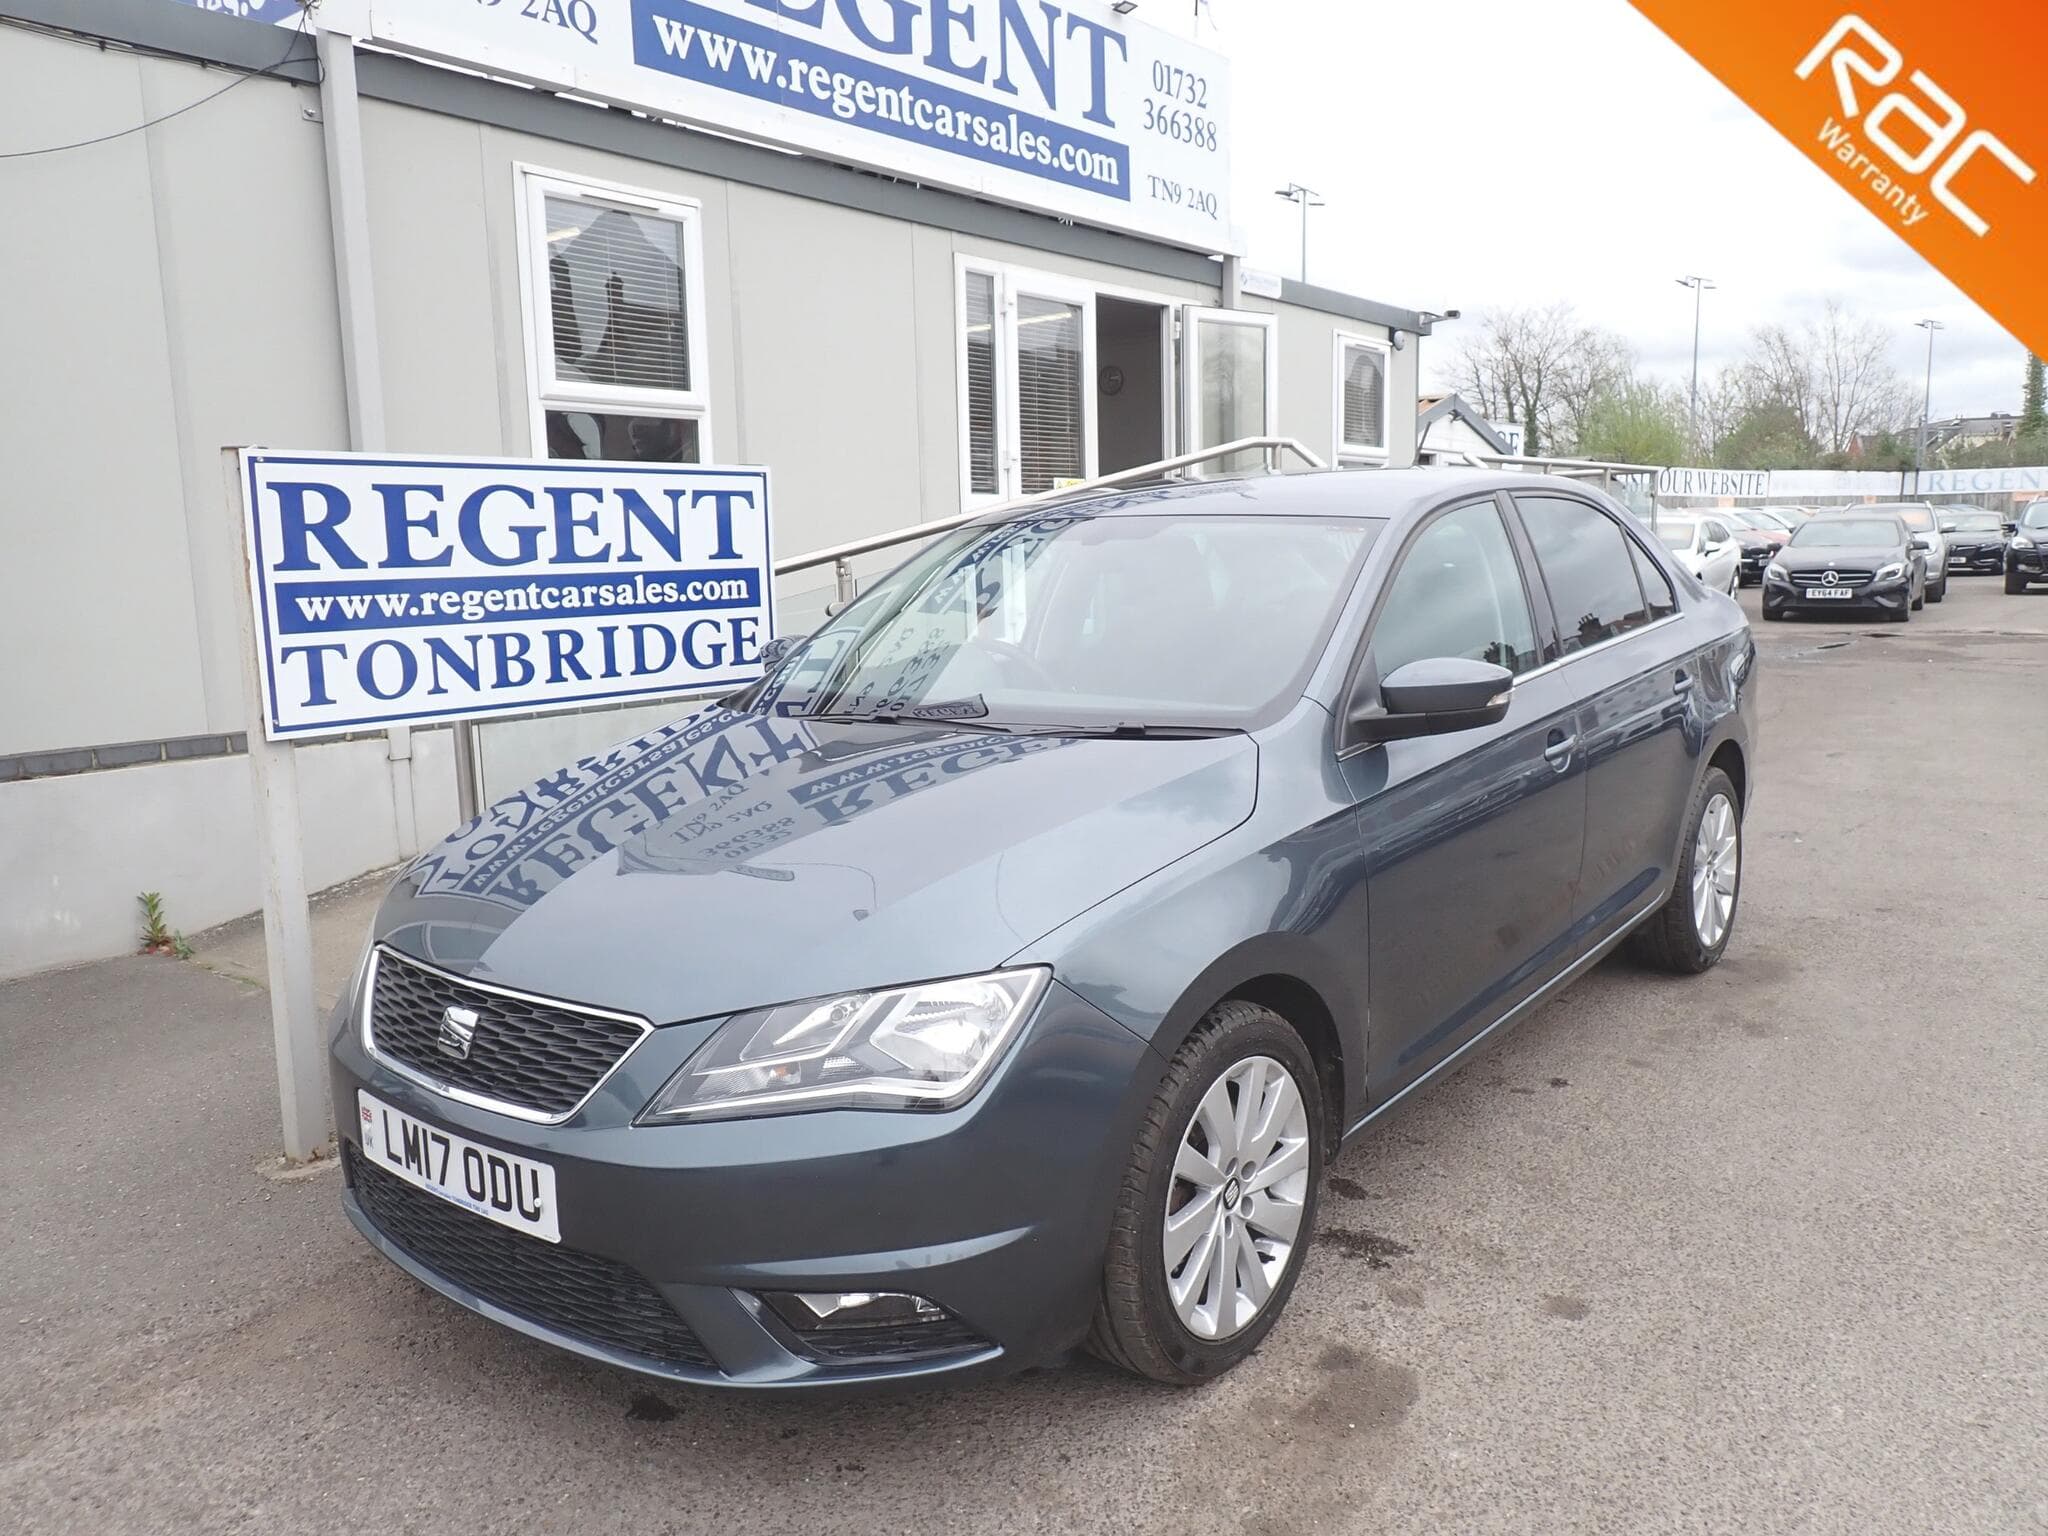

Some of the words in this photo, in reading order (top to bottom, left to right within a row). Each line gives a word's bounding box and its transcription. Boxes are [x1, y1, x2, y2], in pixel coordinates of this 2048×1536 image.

[652, 15, 1120, 185] www.regentcarsales.com
[1153, 59, 1208, 109] 01732
[1143, 98, 1217, 152] 366388
[1147, 174, 1182, 204] TN9
[1187, 188, 1217, 220] 2AQ
[1660, 469, 1693, 494] OUR
[1697, 471, 1765, 496] WEBSITE
[266, 481, 755, 572] REGENT
[295, 575, 749, 623] www.regentcarsales.com
[280, 617, 762, 708] TONBRIDGE
[383, 1109, 450, 1187] LM17
[463, 1146, 541, 1223] ODU
